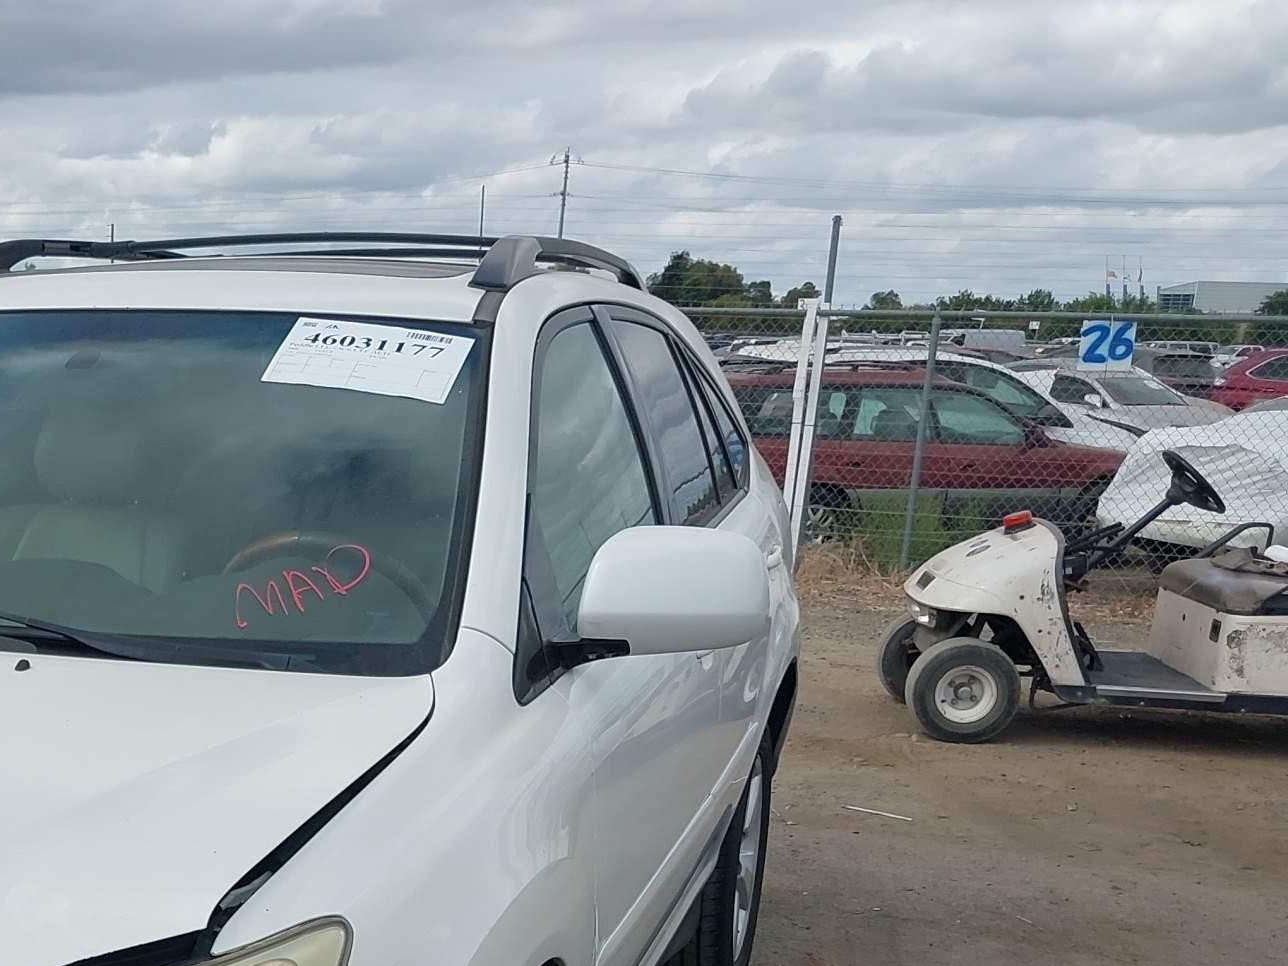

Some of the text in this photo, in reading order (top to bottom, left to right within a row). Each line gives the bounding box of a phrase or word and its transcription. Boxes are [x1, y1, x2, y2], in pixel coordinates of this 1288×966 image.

[303, 332, 445, 359] 46031177
[1081, 321, 1134, 363] 26
[235, 544, 372, 629] MAD
